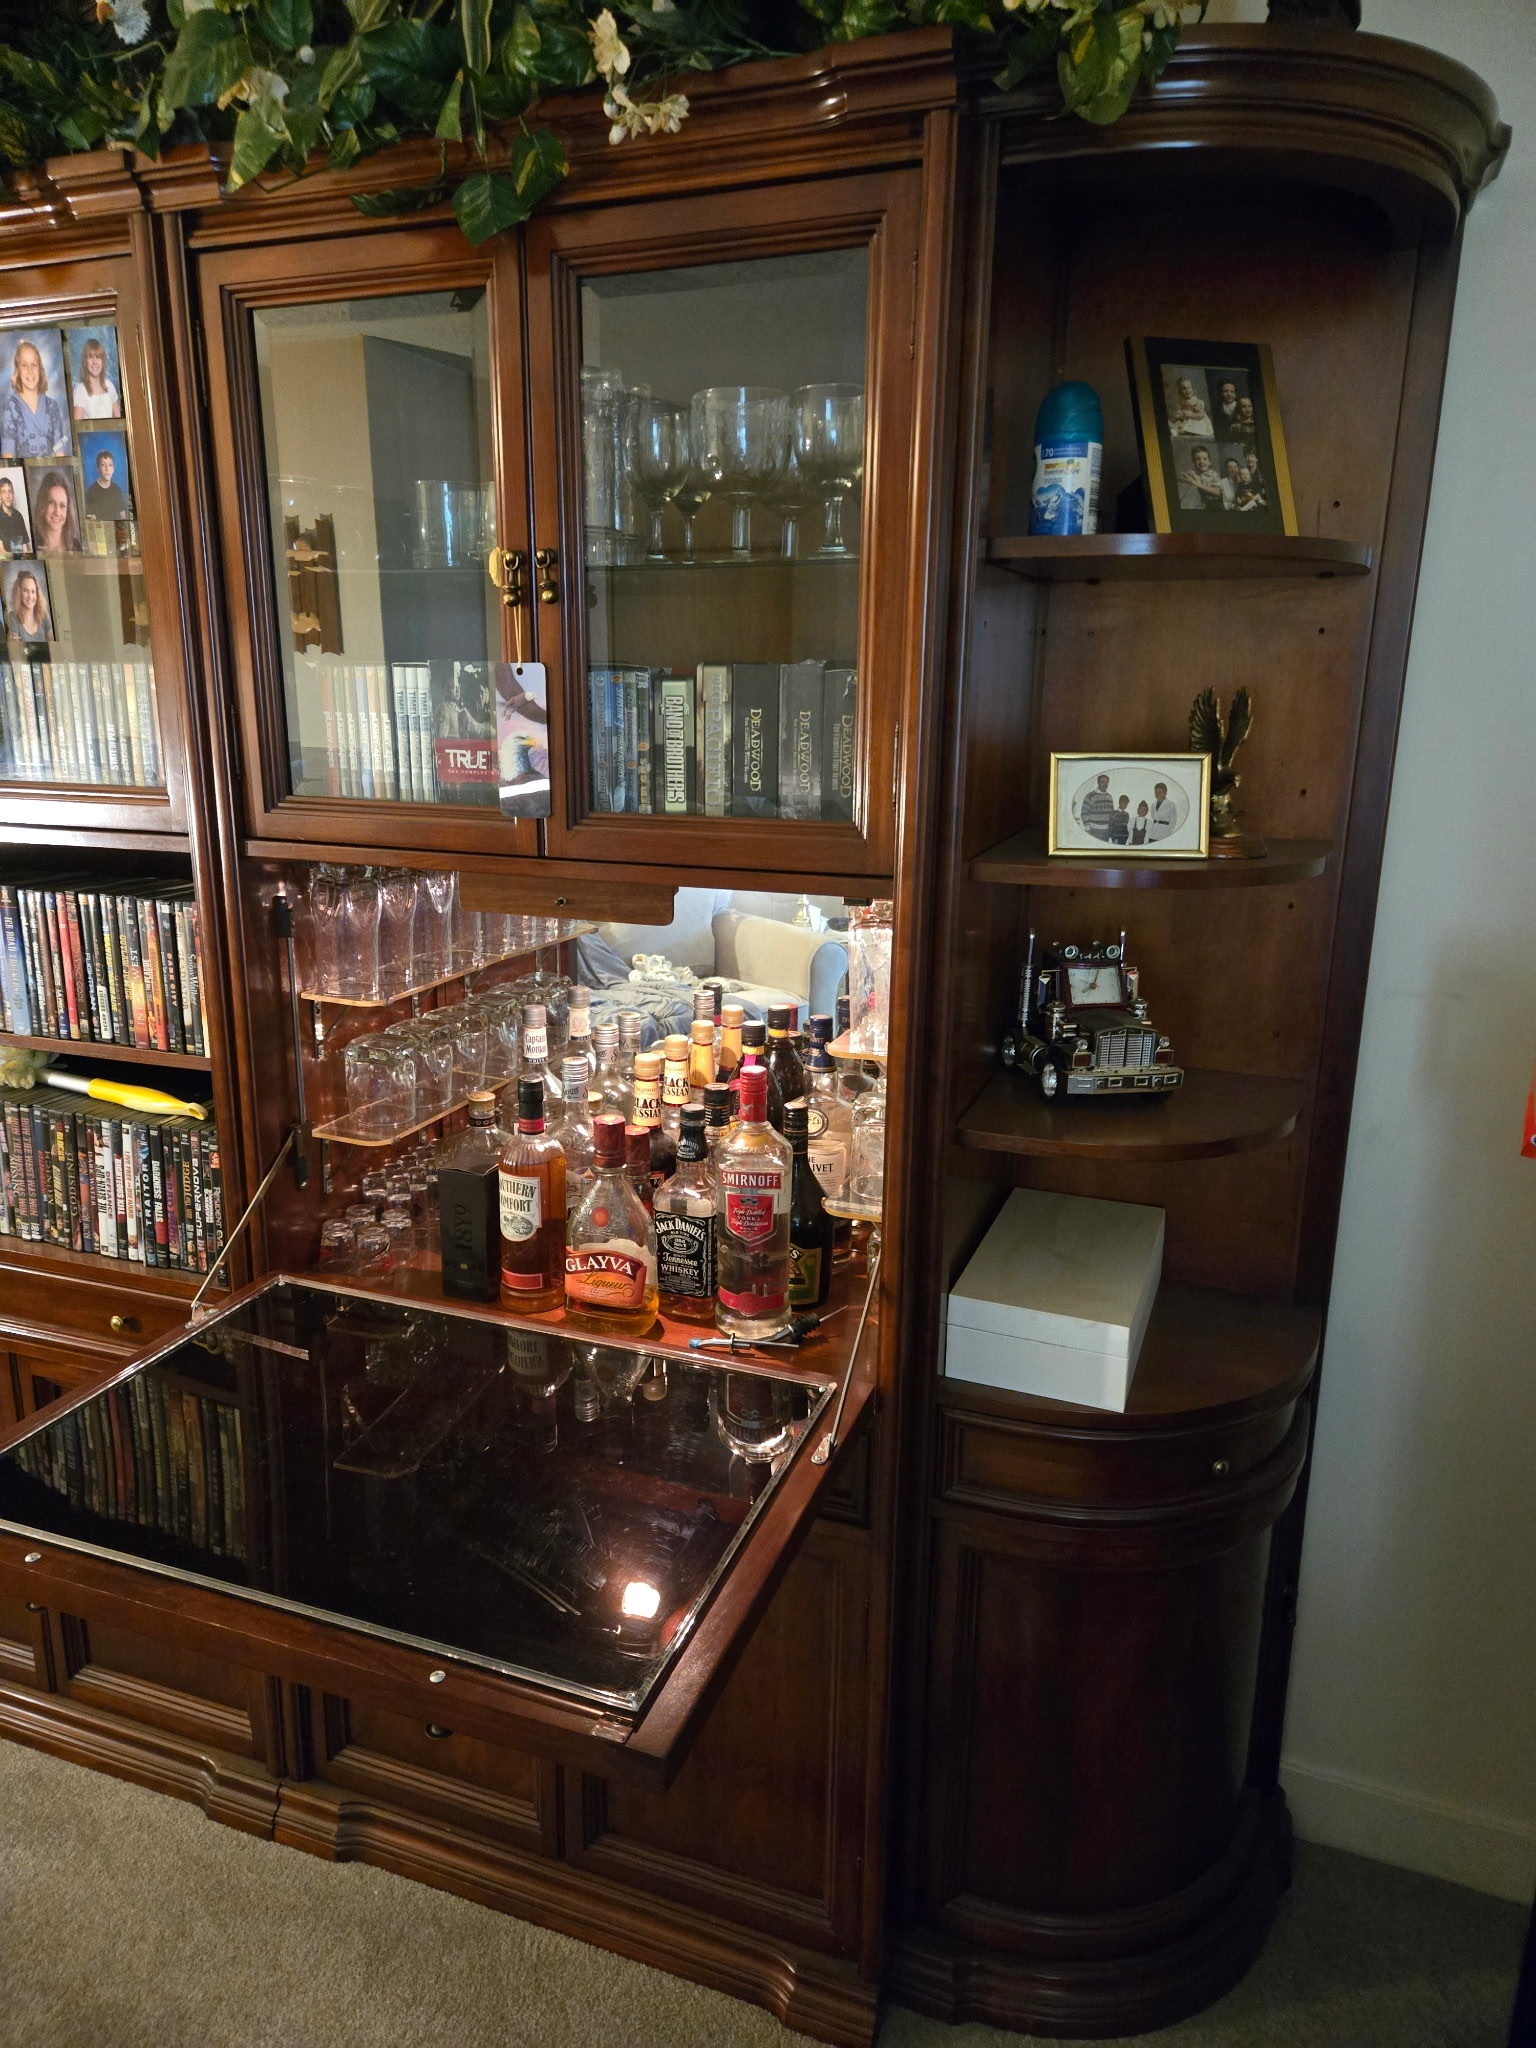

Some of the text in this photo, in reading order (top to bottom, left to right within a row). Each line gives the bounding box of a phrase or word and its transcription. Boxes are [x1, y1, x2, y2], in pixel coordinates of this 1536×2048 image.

[665, 696, 684, 729] BAND
[445, 749, 488, 770] TRUE
[750, 708, 762, 792] DEADWOOD
[800, 710, 811, 793] DEADWOOD
[842, 714, 854, 798] DEADWOOD
[666, 740, 685, 803] BROTHERS
[85, 952, 96, 1011] FLIGHTPLAN
[130, 948, 140, 980] WEST
[166, 952, 178, 1007] DARK CITY
[664, 1077, 689, 1088] LACK
[634, 1098, 663, 1108] LACK
[57, 1132, 65, 1162] BLOCKS
[45, 1151, 54, 1204] MUNICH
[66, 1152, 78, 1216] GODSEND
[142, 1164, 152, 1226] TRAITOR
[152, 1160, 164, 1222] DARKNESS FALLS
[182, 1162, 192, 1199] JUDGE
[722, 1172, 779, 1188] SMIRNOFF
[98, 1202, 107, 1214] THE
[192, 1158, 202, 1236] SUPERNOVA
[214, 1186, 222, 1228] RESIDENT
[656, 1218, 706, 1241] JACK DANIEL'S
[566, 1255, 632, 1275] GLAYVA
[661, 1264, 699, 1276] WHISKEY
[662, 1252, 698, 1266] Tennessee
[576, 1272, 631, 1292] Liqueur
